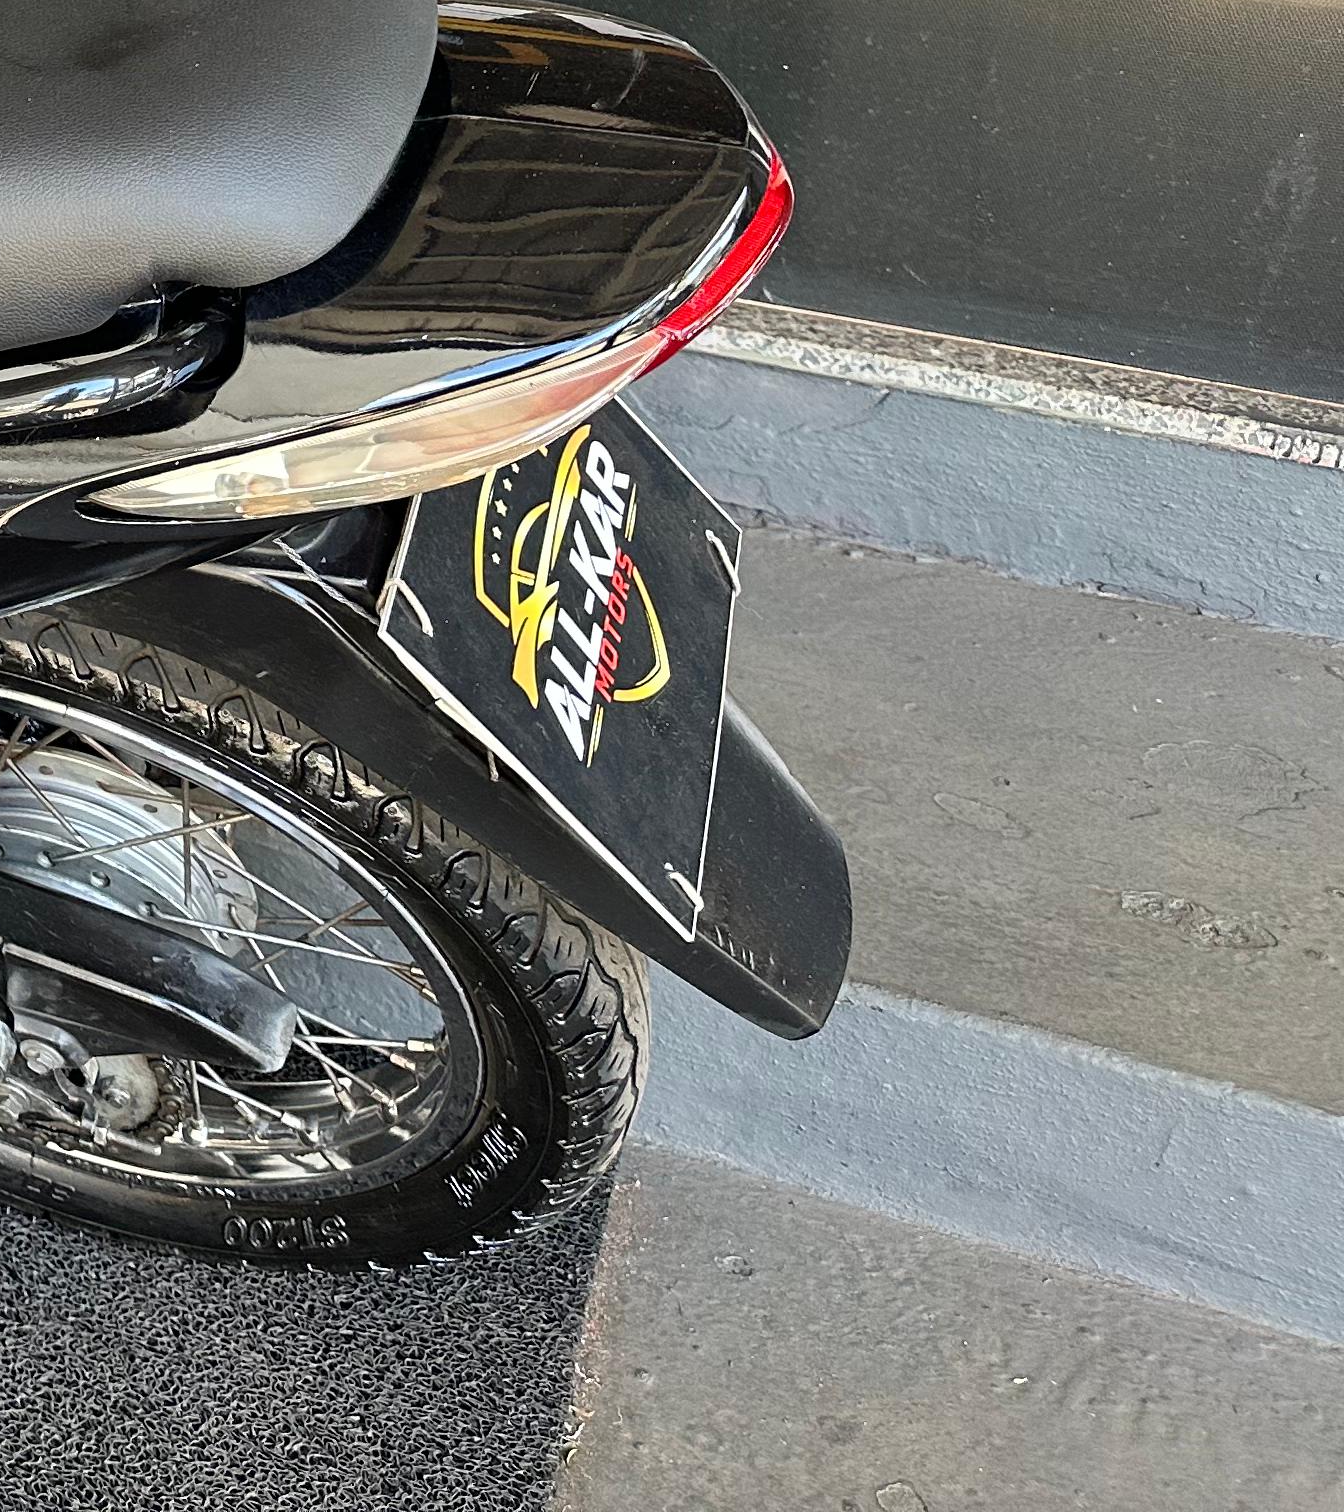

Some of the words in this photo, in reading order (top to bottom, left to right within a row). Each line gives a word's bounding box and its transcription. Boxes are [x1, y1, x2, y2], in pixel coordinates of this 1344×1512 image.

[543, 440, 631, 762] ALL-KAR
[593, 545, 634, 703] MOTORS
[222, 1214, 350, 1251] ST200
